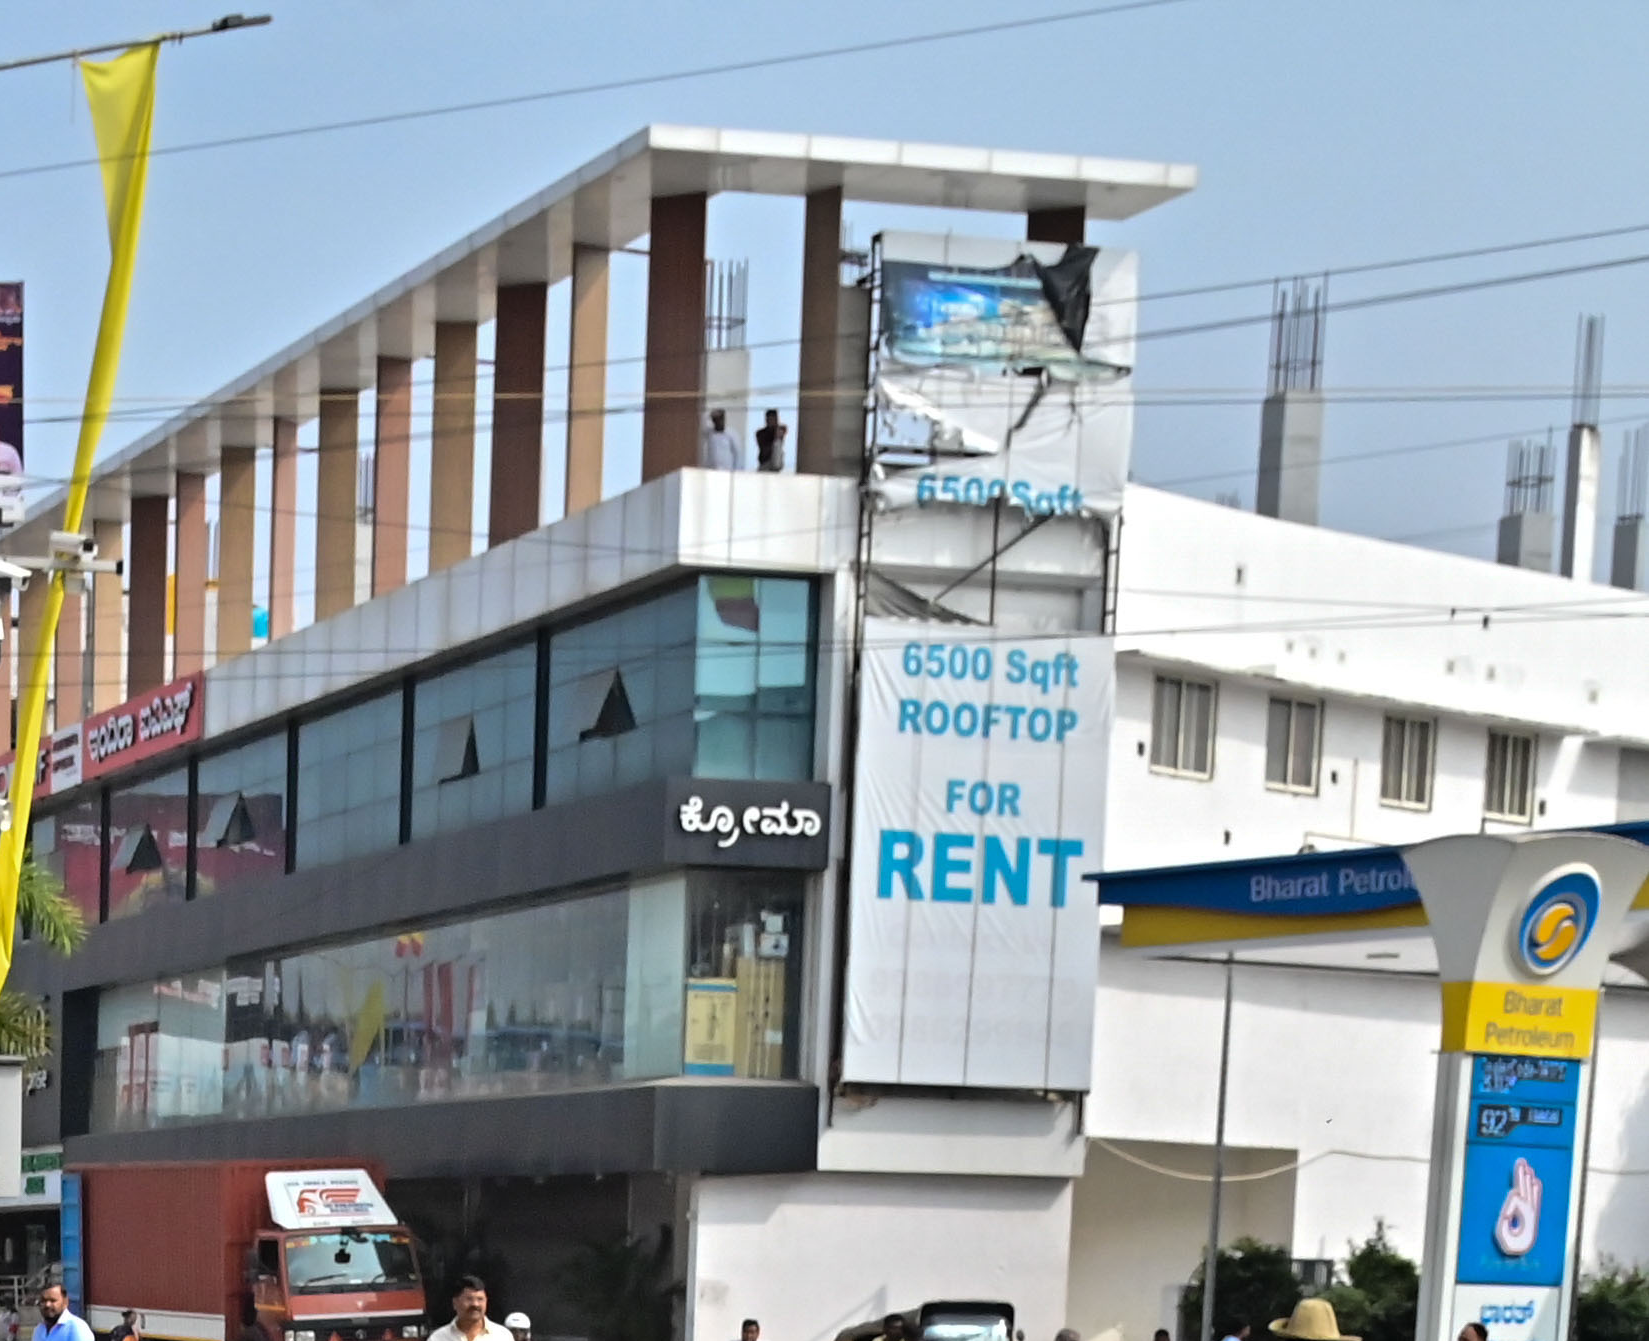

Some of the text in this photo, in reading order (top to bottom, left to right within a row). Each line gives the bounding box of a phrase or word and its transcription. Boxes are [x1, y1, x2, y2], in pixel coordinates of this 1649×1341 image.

[902, 641, 1080, 695] 6500 Sqft
[898, 698, 1078, 744] ROOFTOP
[945, 780, 1021, 816] FOR
[678, 796, 821, 847] ಕ್ರೋಮಾ
[877, 829, 1085, 908] RENT
[1251, 871, 1330, 902] Bharat
[1504, 989, 1563, 1017] Bharat
[1484, 1021, 1576, 1049] Petroleum
